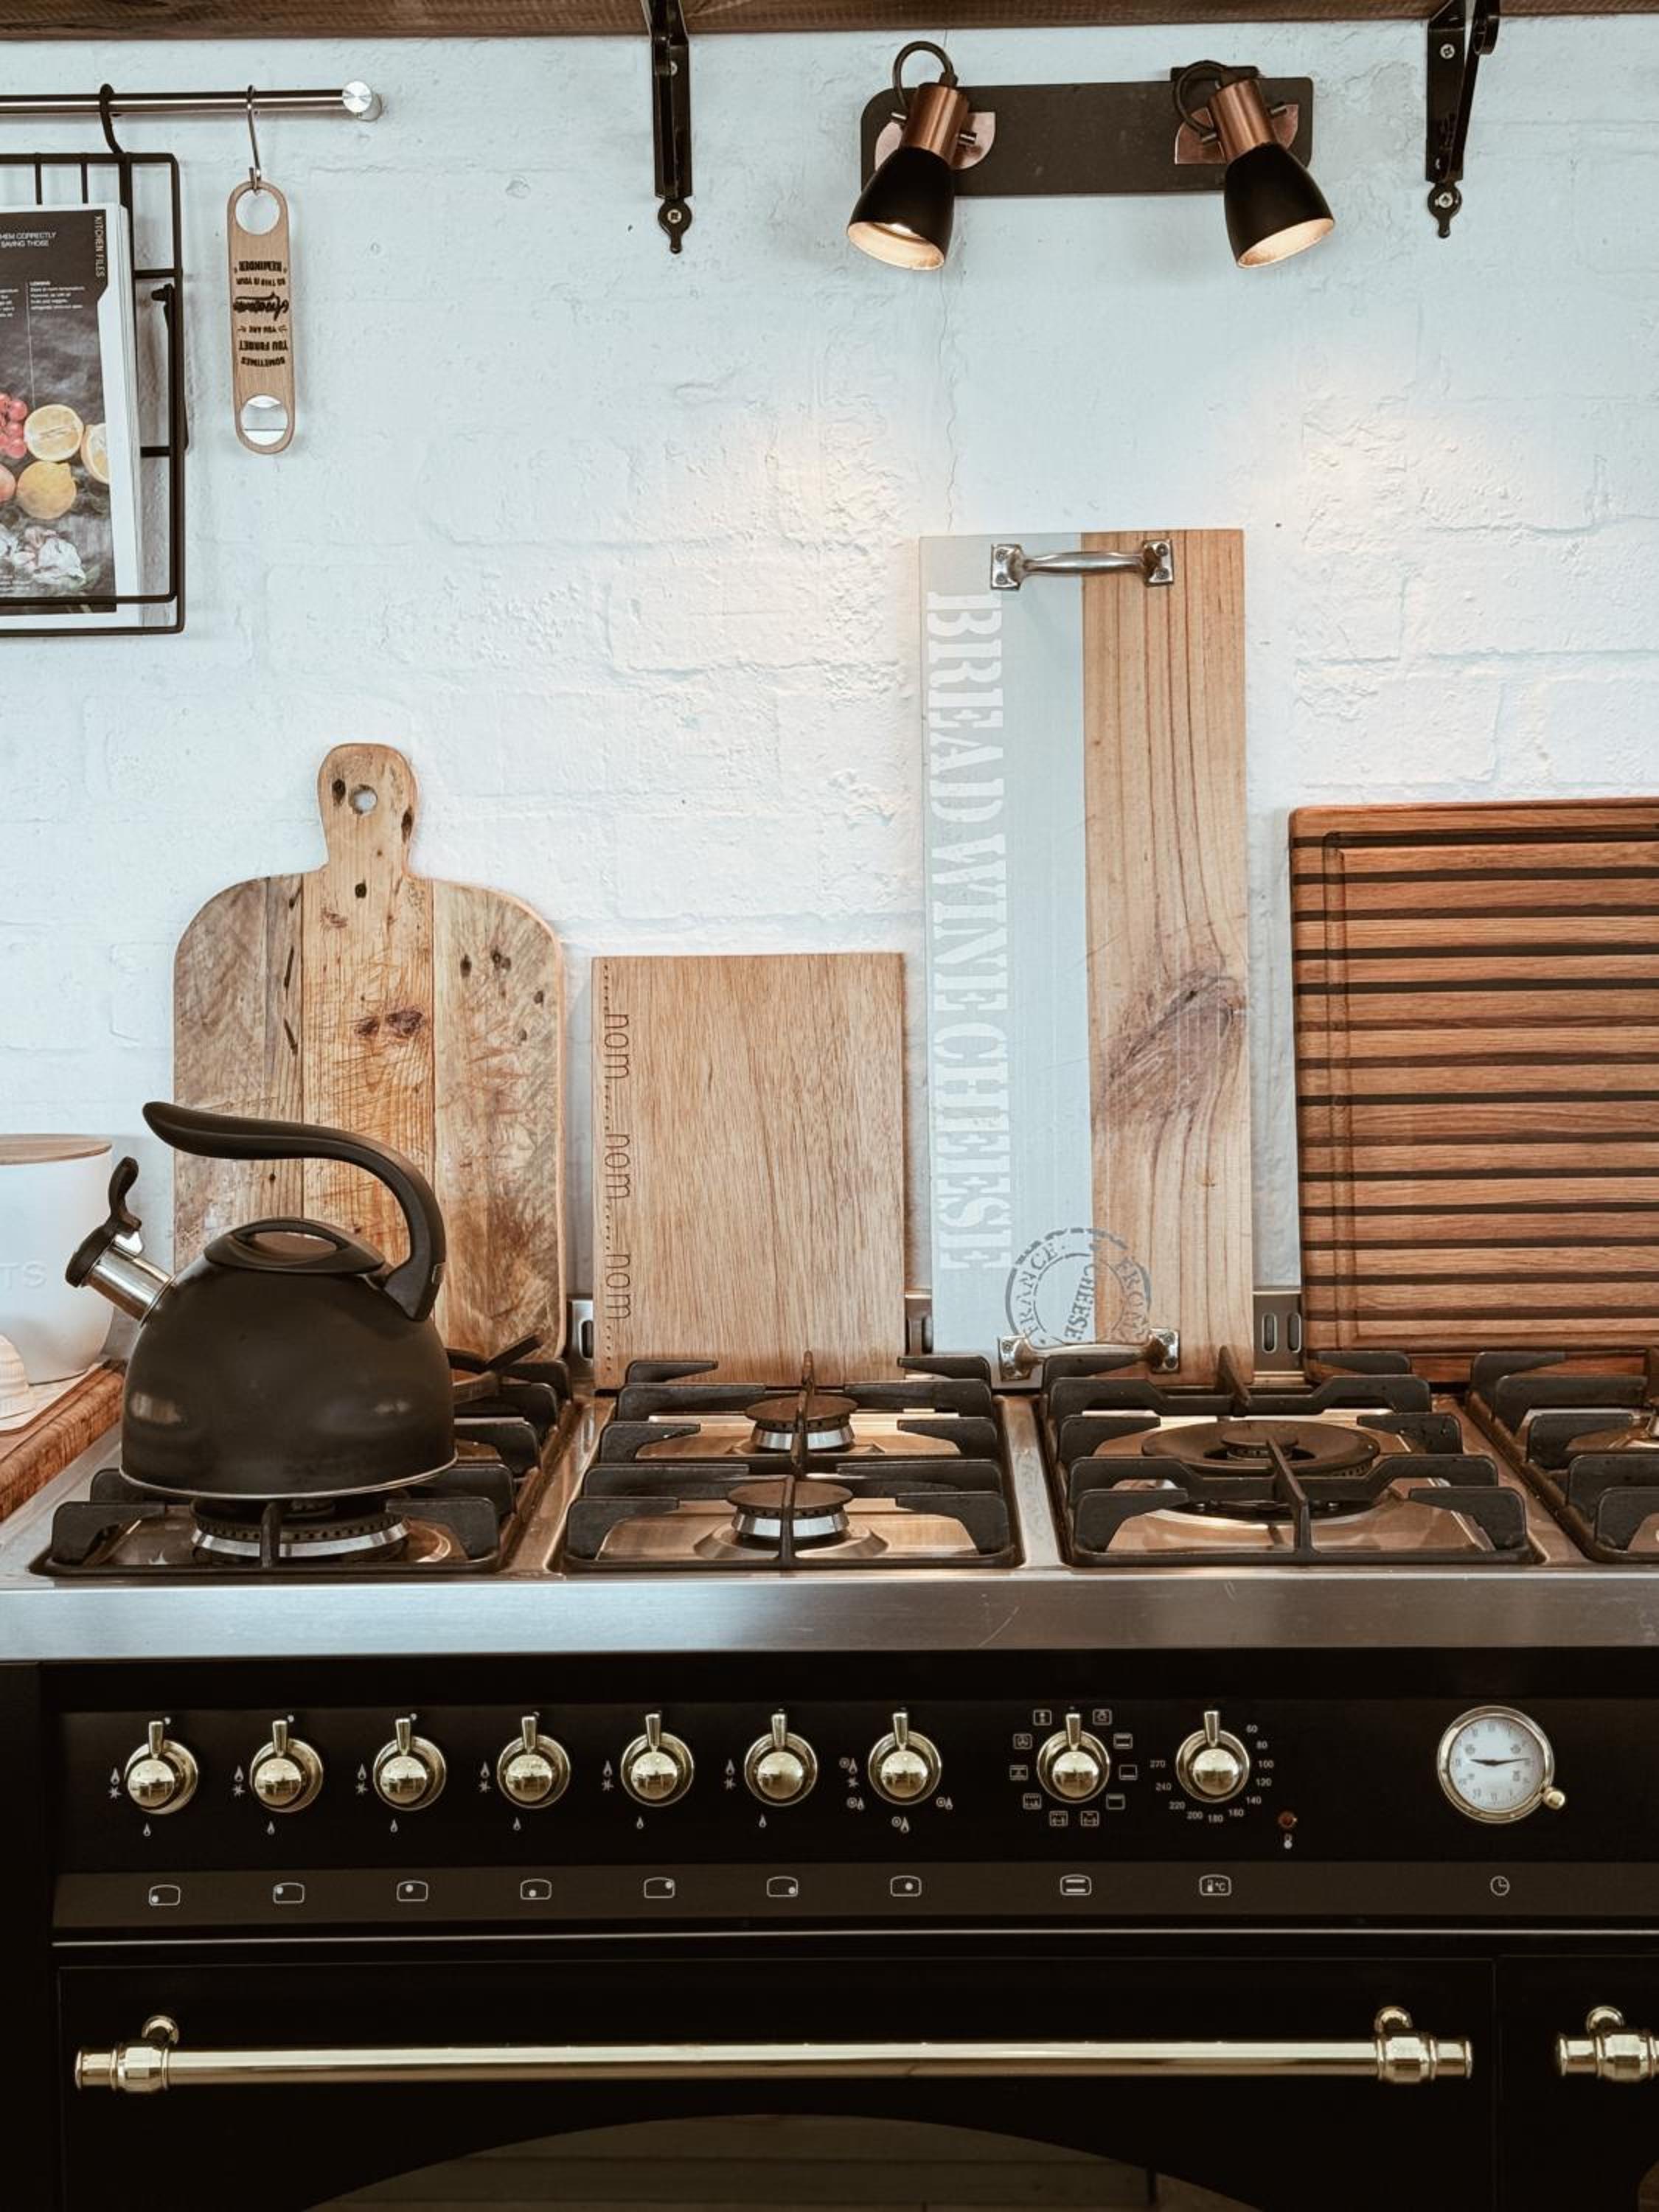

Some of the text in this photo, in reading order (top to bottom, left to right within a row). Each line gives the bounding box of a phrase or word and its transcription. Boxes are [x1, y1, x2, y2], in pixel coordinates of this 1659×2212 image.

[94, 215, 106, 278] KITCHEN FILES
[238, 260, 282, 272] REMINDER
[248, 325, 262, 333] ARE
[238, 340, 288, 351] YOU FORGET
[240, 355, 286, 367] SOMETIMES
[926, 591, 1013, 1270] BREAD WINE CHEESE
[1064, 1263, 1097, 1340] CHEESE
[1246, 1725, 1258, 1733] 60
[1150, 1759, 1166, 1768] 270
[1258, 1760, 1274, 1769] 100
[1155, 1782, 1172, 1792] 240
[1246, 1796, 1262, 1805] 140
[1186, 1811, 1203, 1820] 200
[1228, 1808, 1244, 1818] 160
[1208, 1814, 1223, 1823] 180
